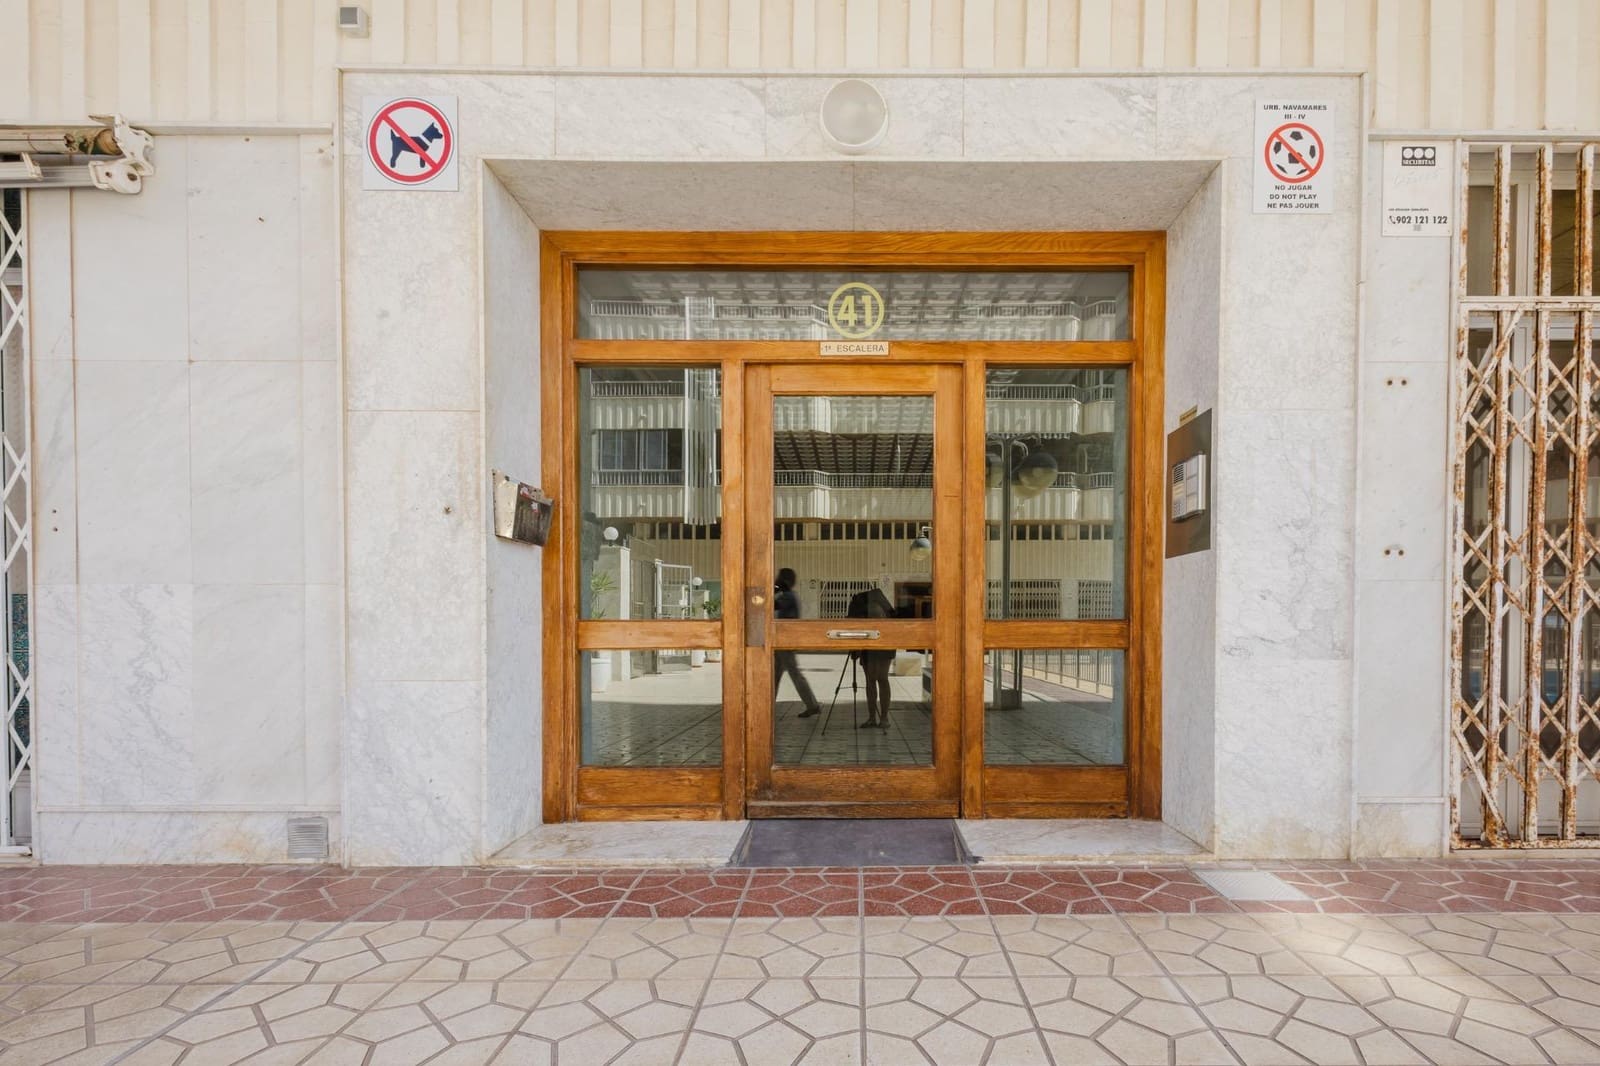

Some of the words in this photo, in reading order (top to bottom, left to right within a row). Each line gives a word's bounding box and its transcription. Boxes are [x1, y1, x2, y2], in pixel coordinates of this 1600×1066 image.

[1396, 215, 1412, 224] 902
[1414, 215, 1429, 224] 121
[1433, 215, 1448, 224] 122
[837, 295, 873, 327] 41
[836, 344, 885, 353] ESCALERA
